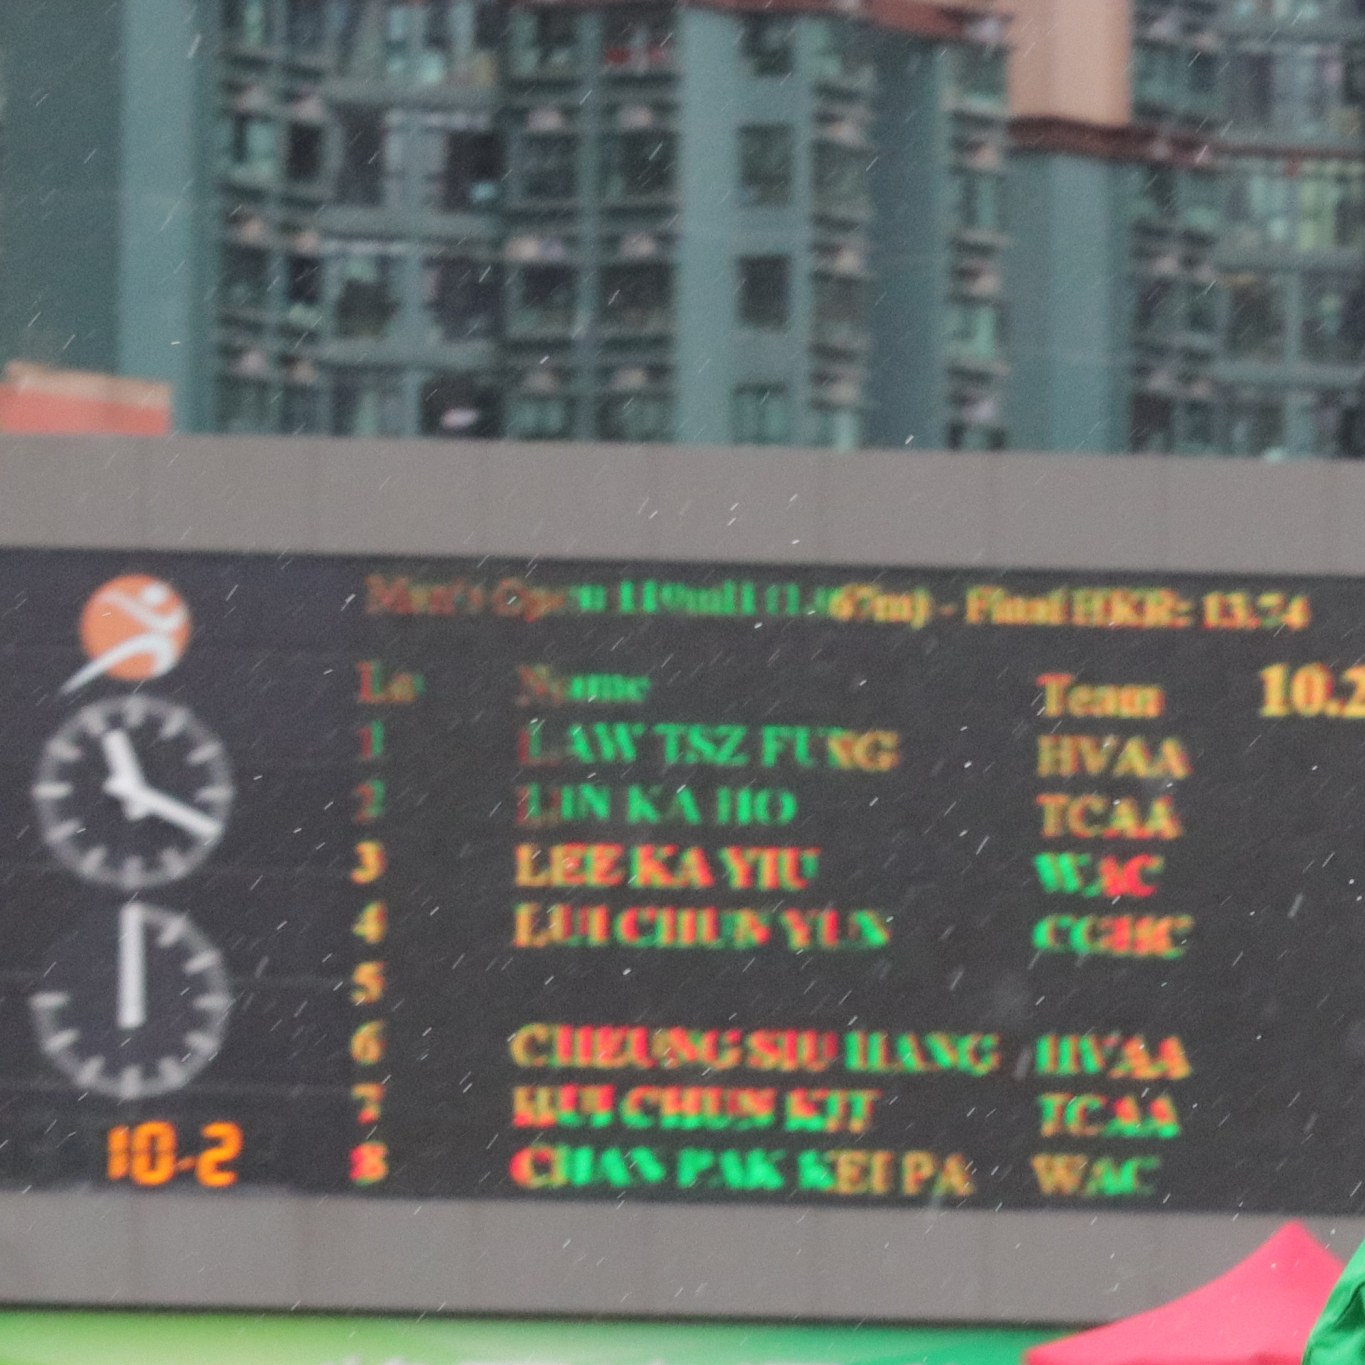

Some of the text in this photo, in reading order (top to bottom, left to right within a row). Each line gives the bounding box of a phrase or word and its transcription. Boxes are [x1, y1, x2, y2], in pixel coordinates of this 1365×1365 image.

[1037, 672, 1164, 718] Team
[518, 722, 645, 765] LAW
[653, 723, 748, 766] TSZ
[761, 725, 899, 772] FUNG
[1036, 734, 1194, 780] HVAA
[354, 779, 387, 824] 2
[626, 785, 701, 826] KA
[717, 786, 798, 826] HO
[1035, 794, 1183, 840] TCAA
[352, 841, 1165, 898] 3 LEE KA YIU WAC
[352, 901, 387, 945] 4
[352, 961, 386, 1006] 5
[351, 1019, 386, 1065] 6
[509, 1023, 743, 1071] CHEUNG
[746, 1028, 838, 1072] SIU
[1035, 1033, 1194, 1080] HVAA
[351, 1083, 386, 1125] 7
[1037, 1091, 1181, 1139] TCAA
[350, 1141, 388, 1185] 8
[509, 1143, 665, 1189] CHAN
[677, 1146, 786, 1190] PAK
[902, 1149, 974, 1197] PA
[1032, 1154, 1162, 1198] WAC
